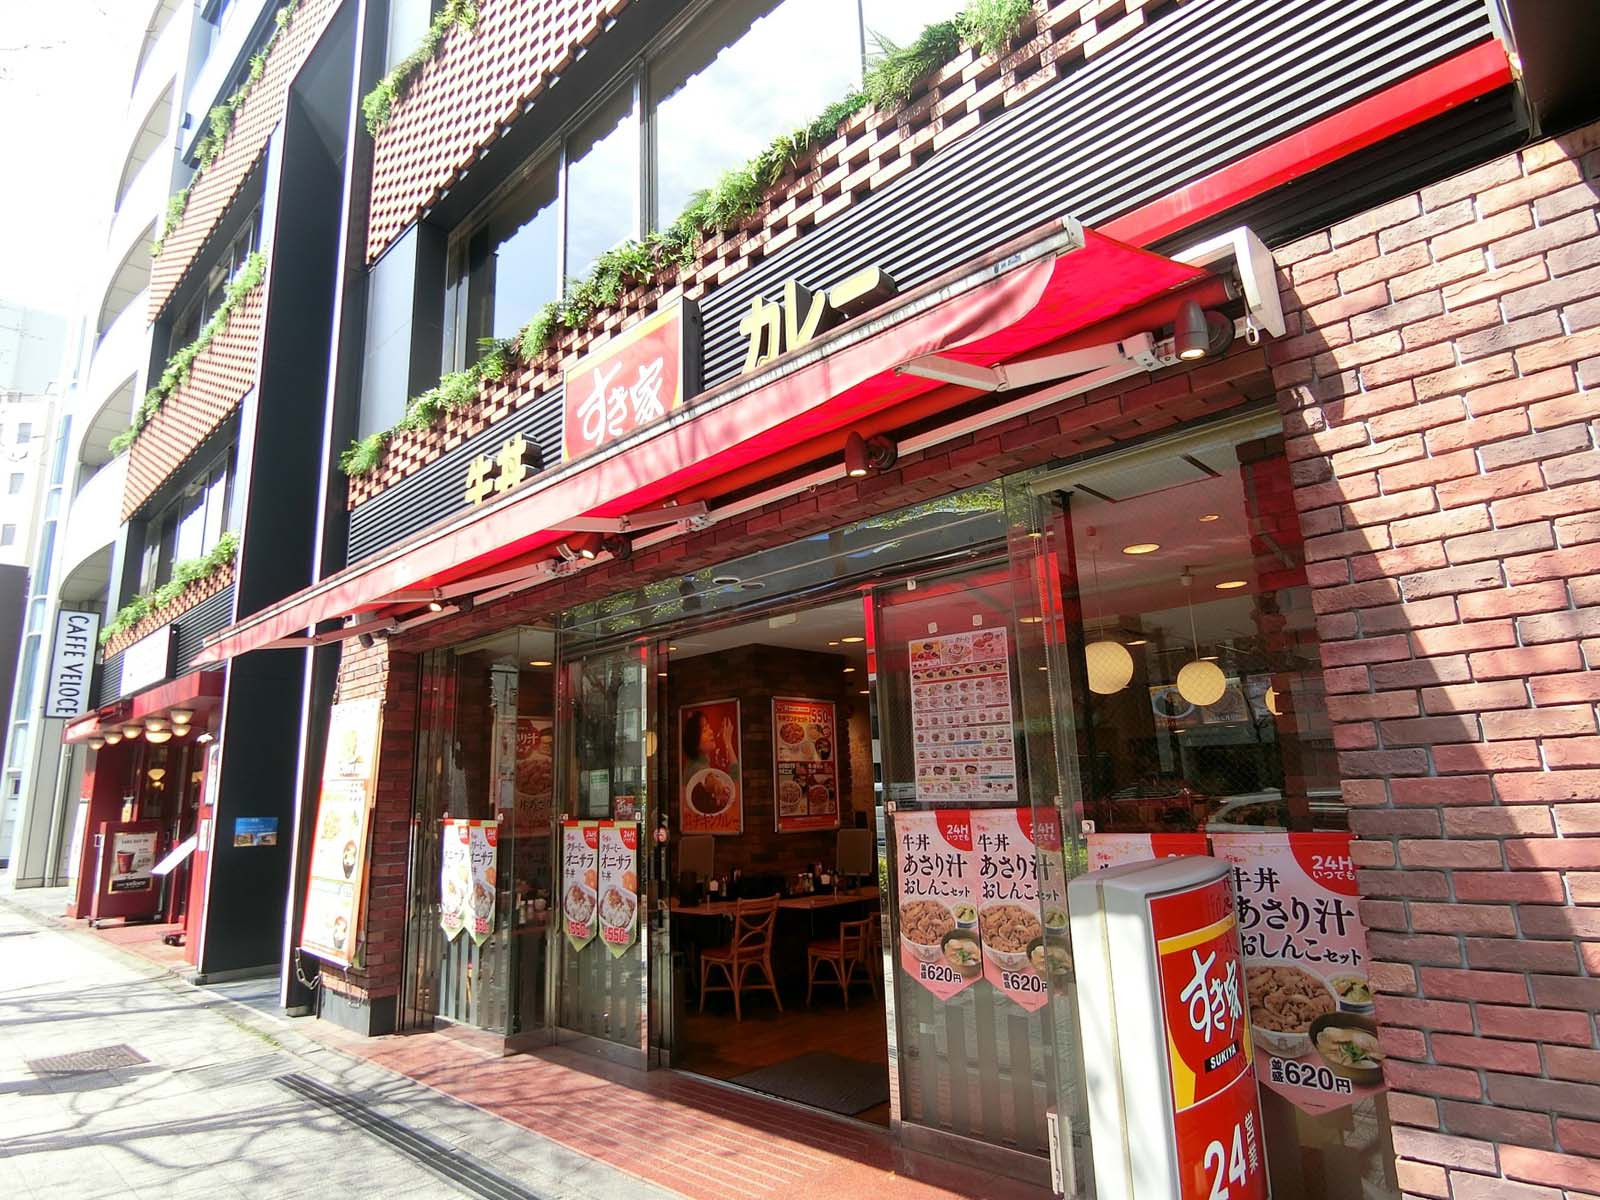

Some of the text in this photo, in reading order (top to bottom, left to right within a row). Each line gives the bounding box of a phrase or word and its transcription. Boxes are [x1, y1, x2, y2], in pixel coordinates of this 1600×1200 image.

[739, 266, 891, 373] カレー
[577, 356, 666, 445] すき家
[464, 432, 527, 505] 牛丼
[55, 615, 90, 715] CAFFE VELOCE
[902, 834, 930, 851] 牛丼
[946, 825, 969, 834] 24H
[977, 834, 1010, 852] 牛丼
[601, 854, 632, 870] オニサラ
[903, 853, 968, 879] あさり汁
[980, 854, 1055, 881] あさり汁
[1311, 855, 1353, 870] 24H
[1312, 870, 1356, 880] いつでも
[904, 878, 971, 898] おしんこセット
[982, 881, 1060, 902] おしんこセット
[1232, 867, 1280, 893] 牛丼
[1236, 895, 1355, 937] あさり汁
[1240, 932, 1362, 966] おしんこセット
[1180, 948, 1243, 1043] すき家
[1209, 1043, 1238, 1069] SUKIYA
[1285, 1061, 1352, 1094] 620円
[1203, 1122, 1247, 1200] 24
